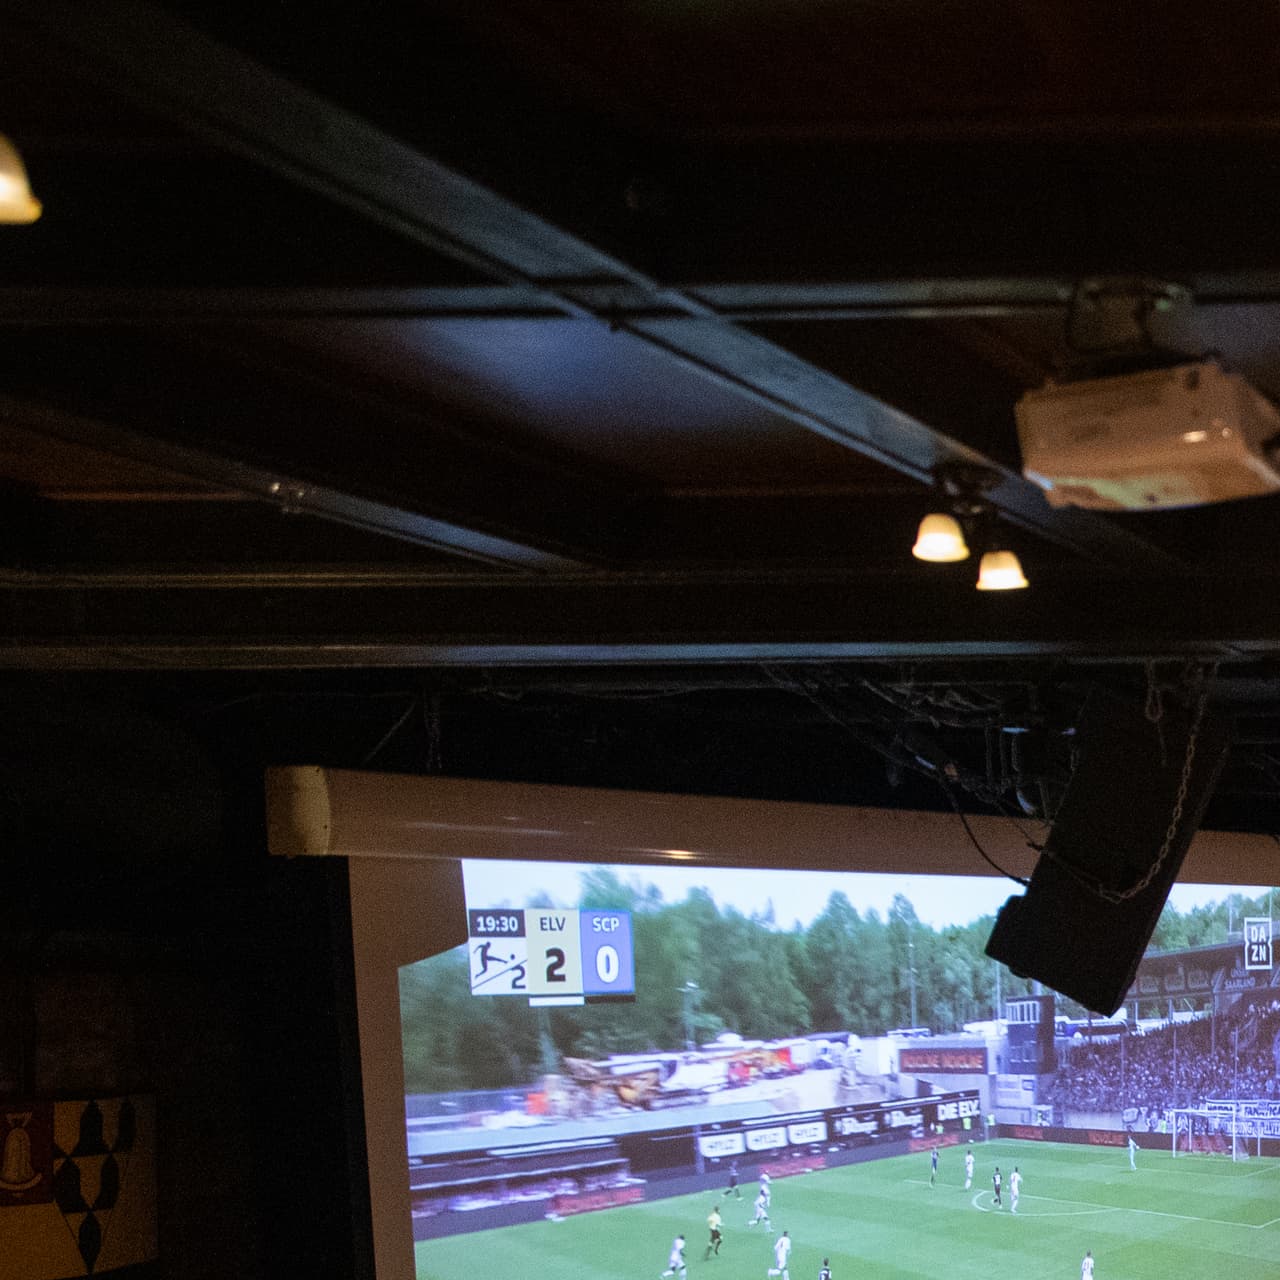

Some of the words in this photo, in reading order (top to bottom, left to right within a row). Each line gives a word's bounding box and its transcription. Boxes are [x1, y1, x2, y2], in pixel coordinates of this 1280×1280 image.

[477, 916, 519, 932] 19:30
[540, 917, 566, 931] ELV
[592, 917, 620, 932] SCP
[545, 947, 567, 983] 2
[596, 945, 619, 983] 0
[511, 964, 527, 989] 2
